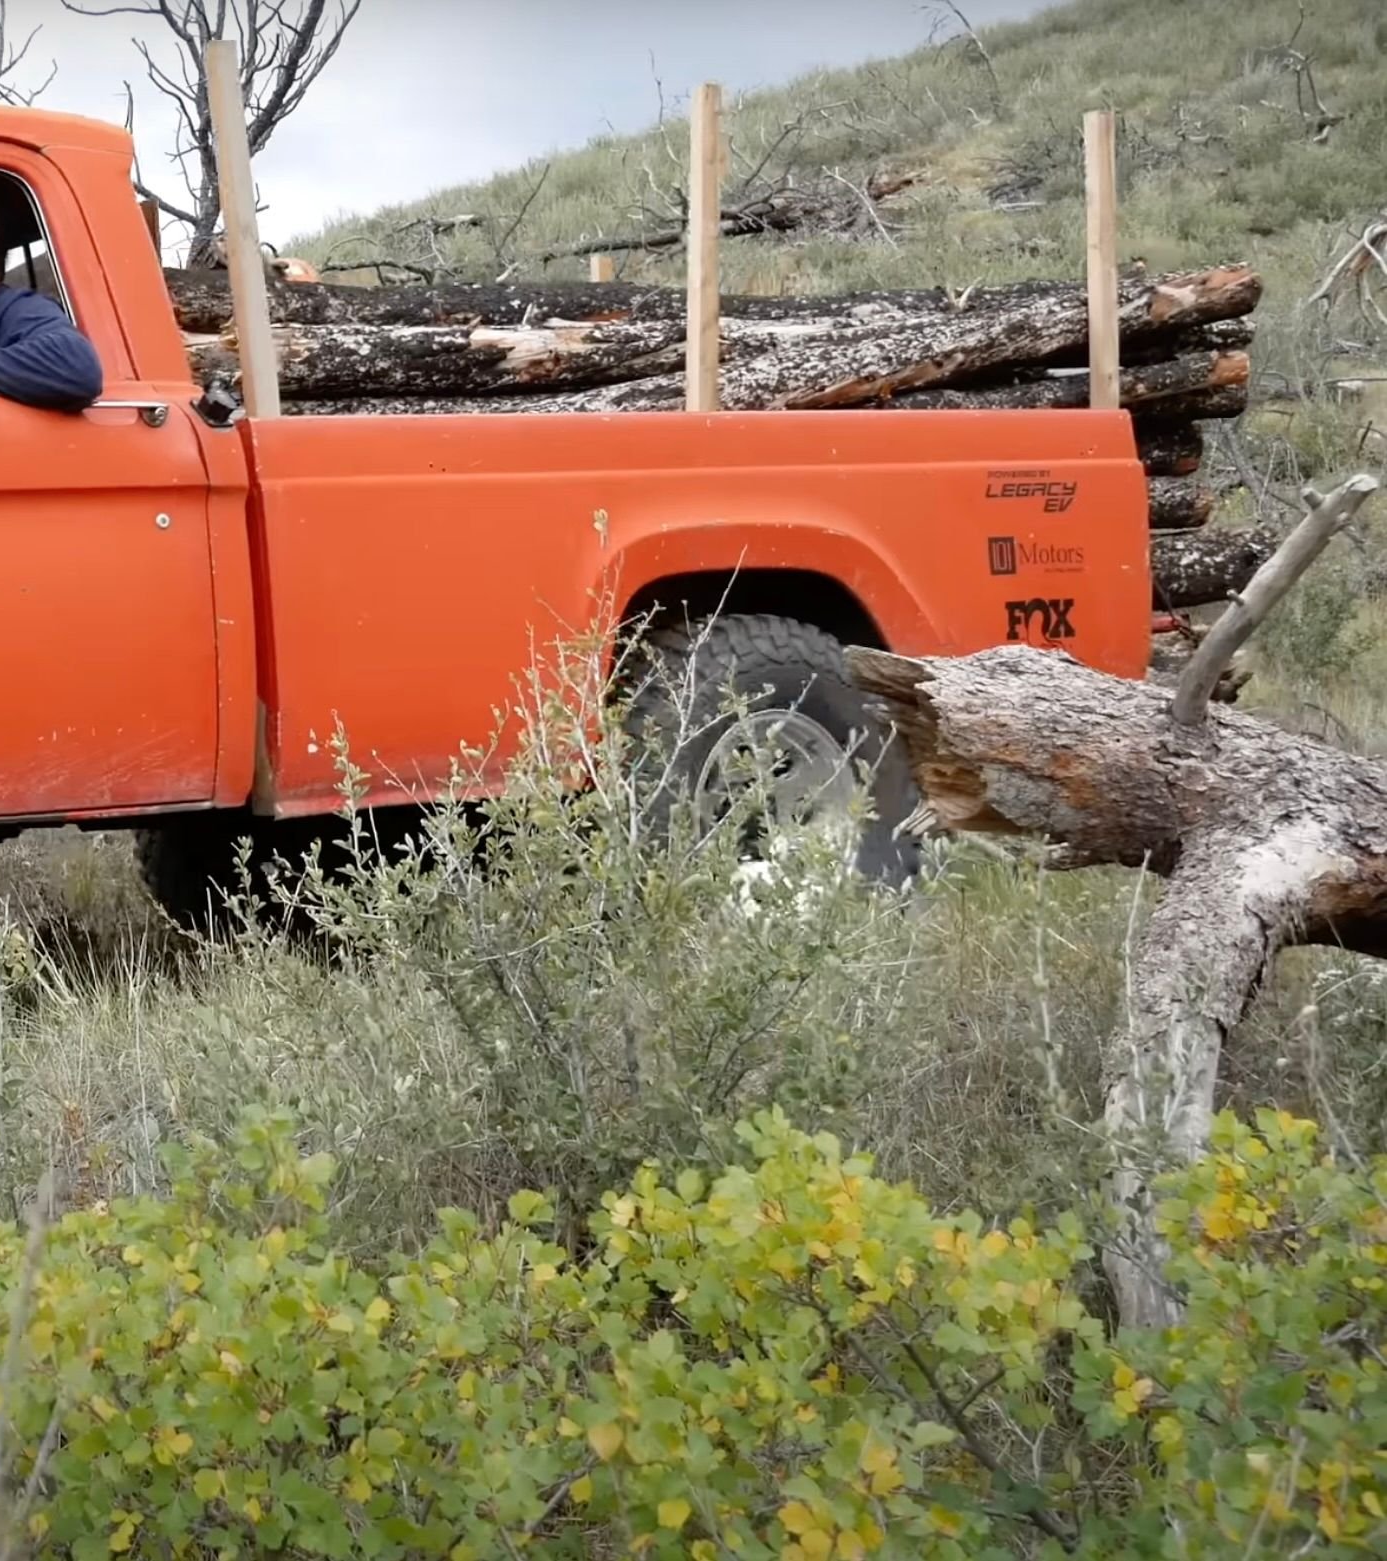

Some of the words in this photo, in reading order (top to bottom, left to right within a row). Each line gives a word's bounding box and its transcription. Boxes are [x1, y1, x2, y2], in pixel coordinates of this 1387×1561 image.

[985, 482, 1077, 498] LEGACY
[1044, 498, 1074, 513] EV
[1018, 542, 1085, 565] Motors
[1005, 598, 1076, 641] FOX
